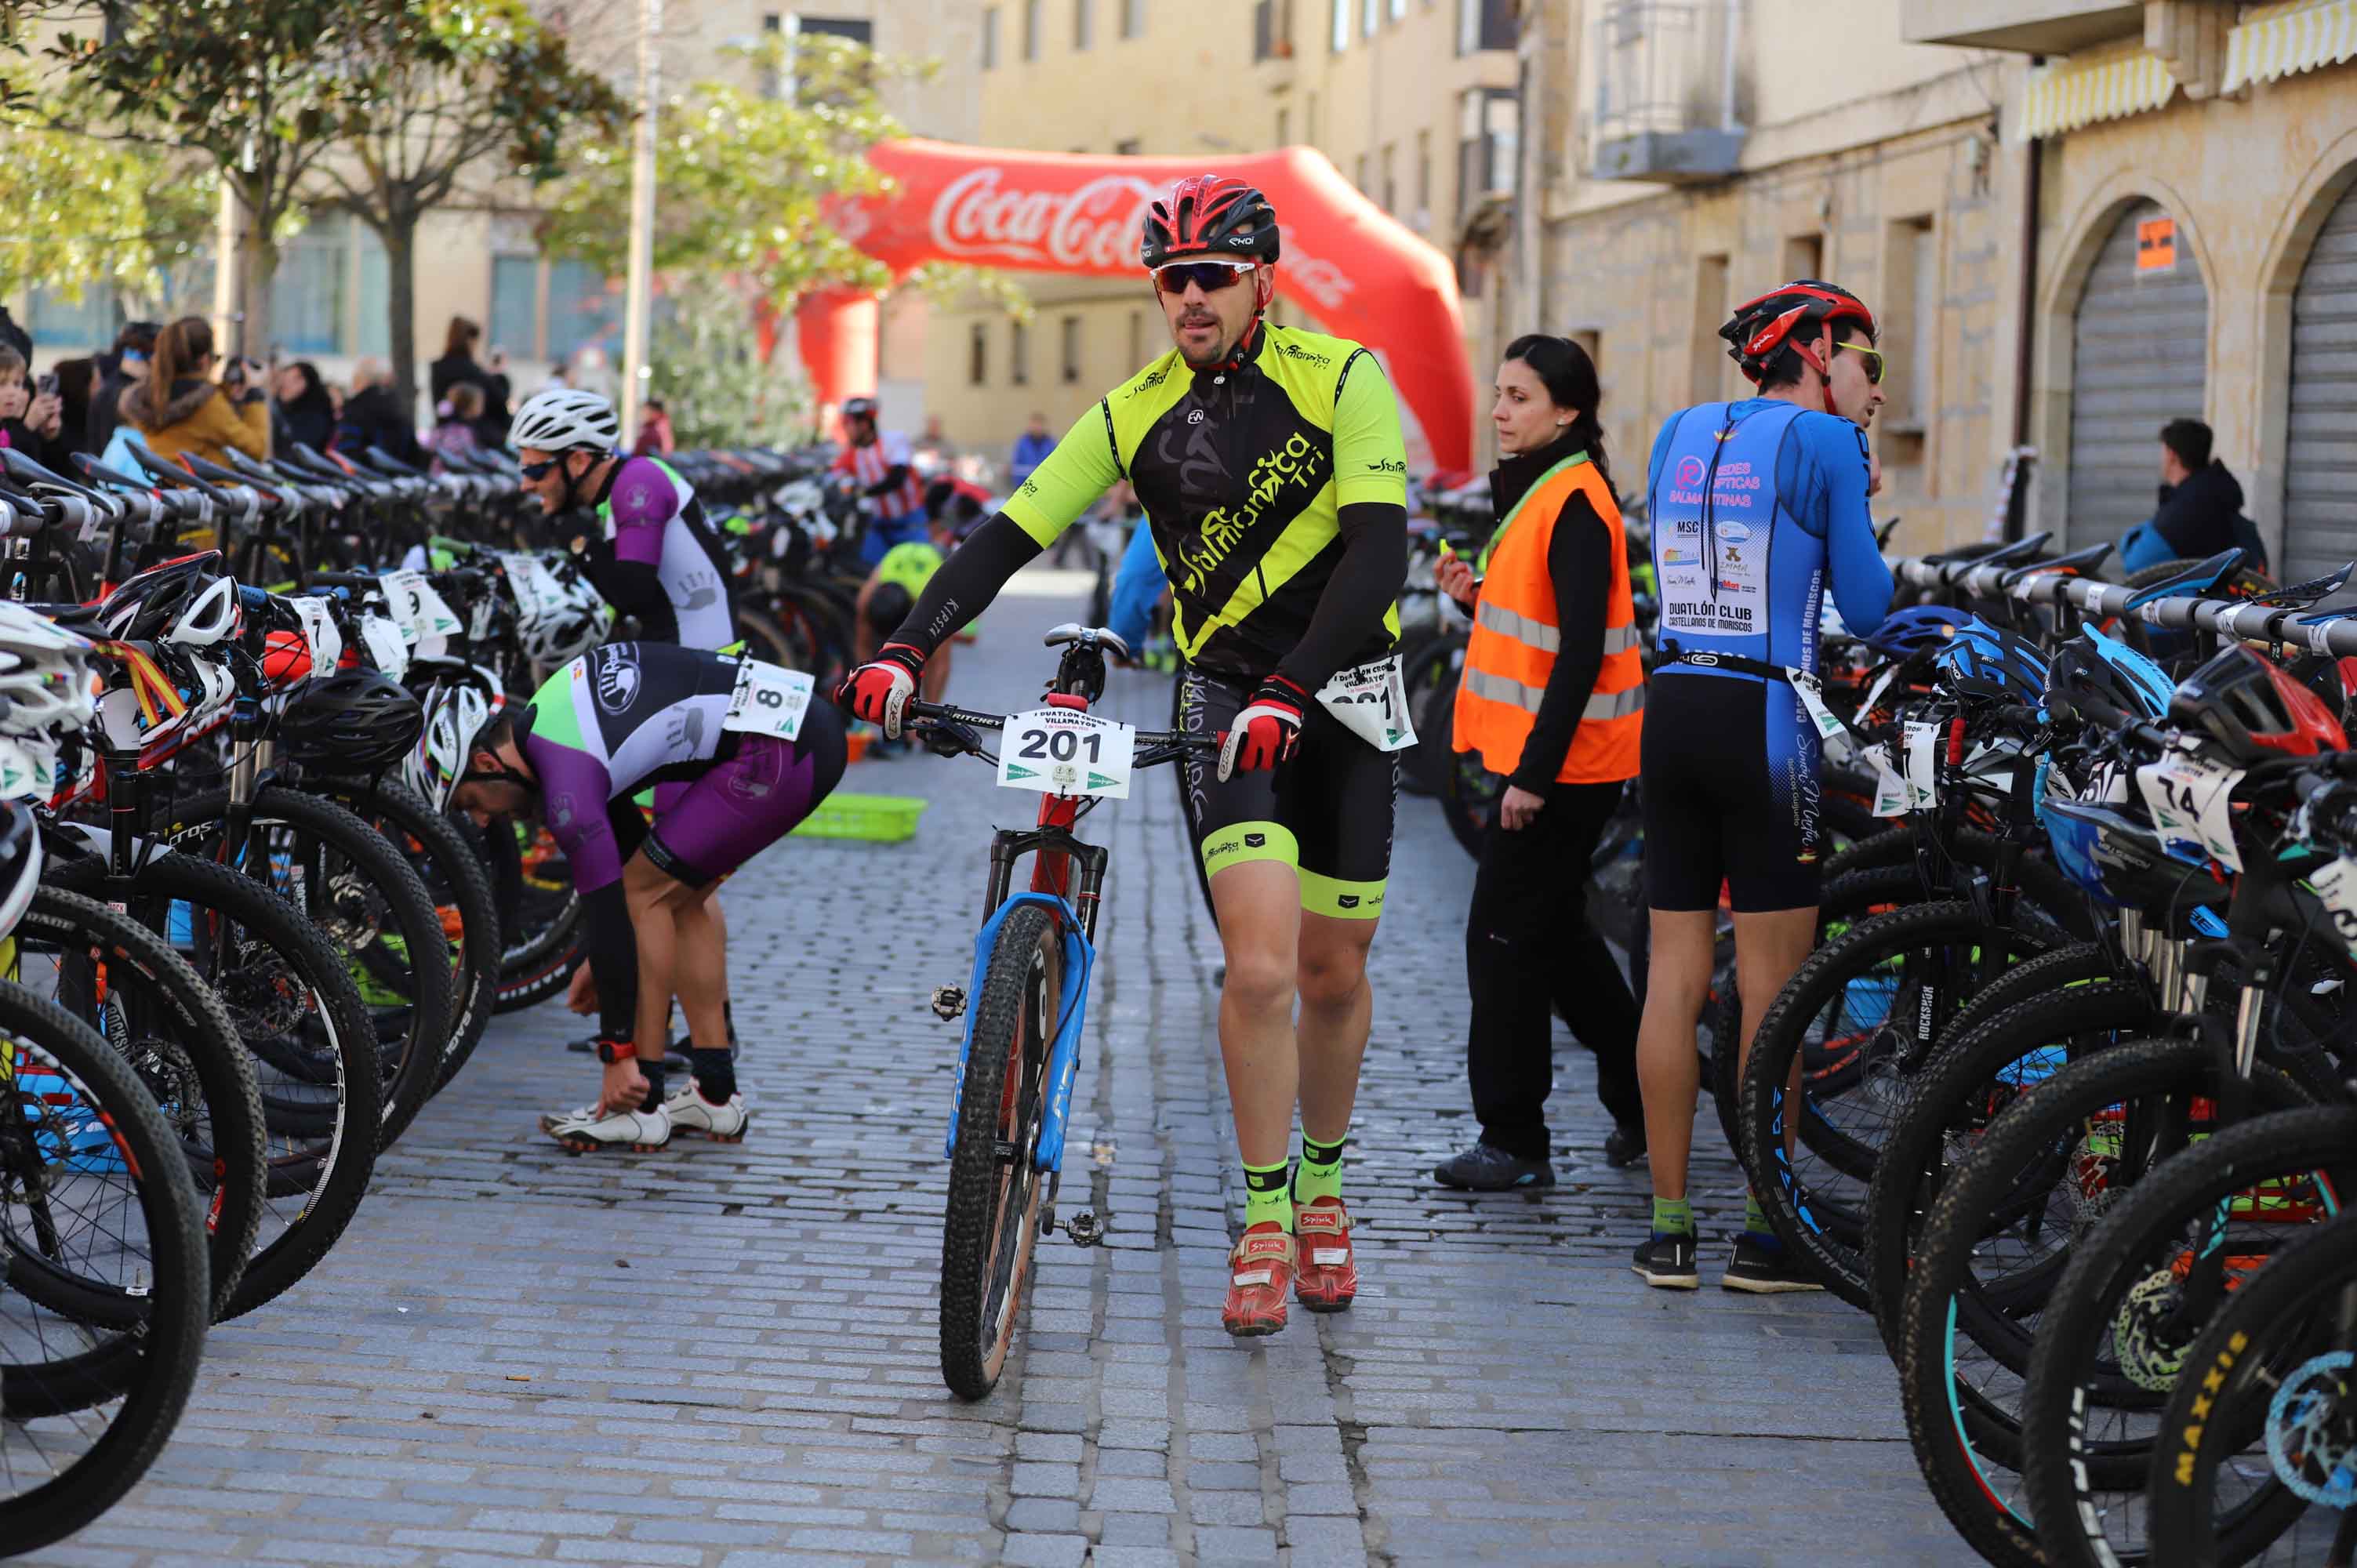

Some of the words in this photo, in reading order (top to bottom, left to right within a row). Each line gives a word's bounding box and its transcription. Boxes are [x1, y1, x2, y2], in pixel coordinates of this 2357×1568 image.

[929, 167, 1165, 269] Coca-Col
[1290, 445, 1325, 488] Tri
[409, 590, 420, 615] 9
[1669, 600, 1716, 617] DUATLÓN
[1719, 604, 1752, 620] CLUB
[1804, 568, 1822, 627] MORISCOS
[928, 598, 960, 637] KIPSTA
[1669, 616, 1707, 628] CASTELLANOS
[1708, 618, 1716, 628] DE
[1718, 619, 1752, 633] MORISCOS
[756, 689, 783, 709] 8
[951, 712, 1004, 726] RITCHEY
[1044, 717, 1097, 728] VILLAMAYOR
[1019, 729, 1101, 764] 201
[2157, 775, 2202, 823] 74
[1302, 1216, 1334, 1225] Spiuk
[1251, 1243, 1282, 1253] Spiuk
[2174, 1330, 2249, 1486] MAXXIS
